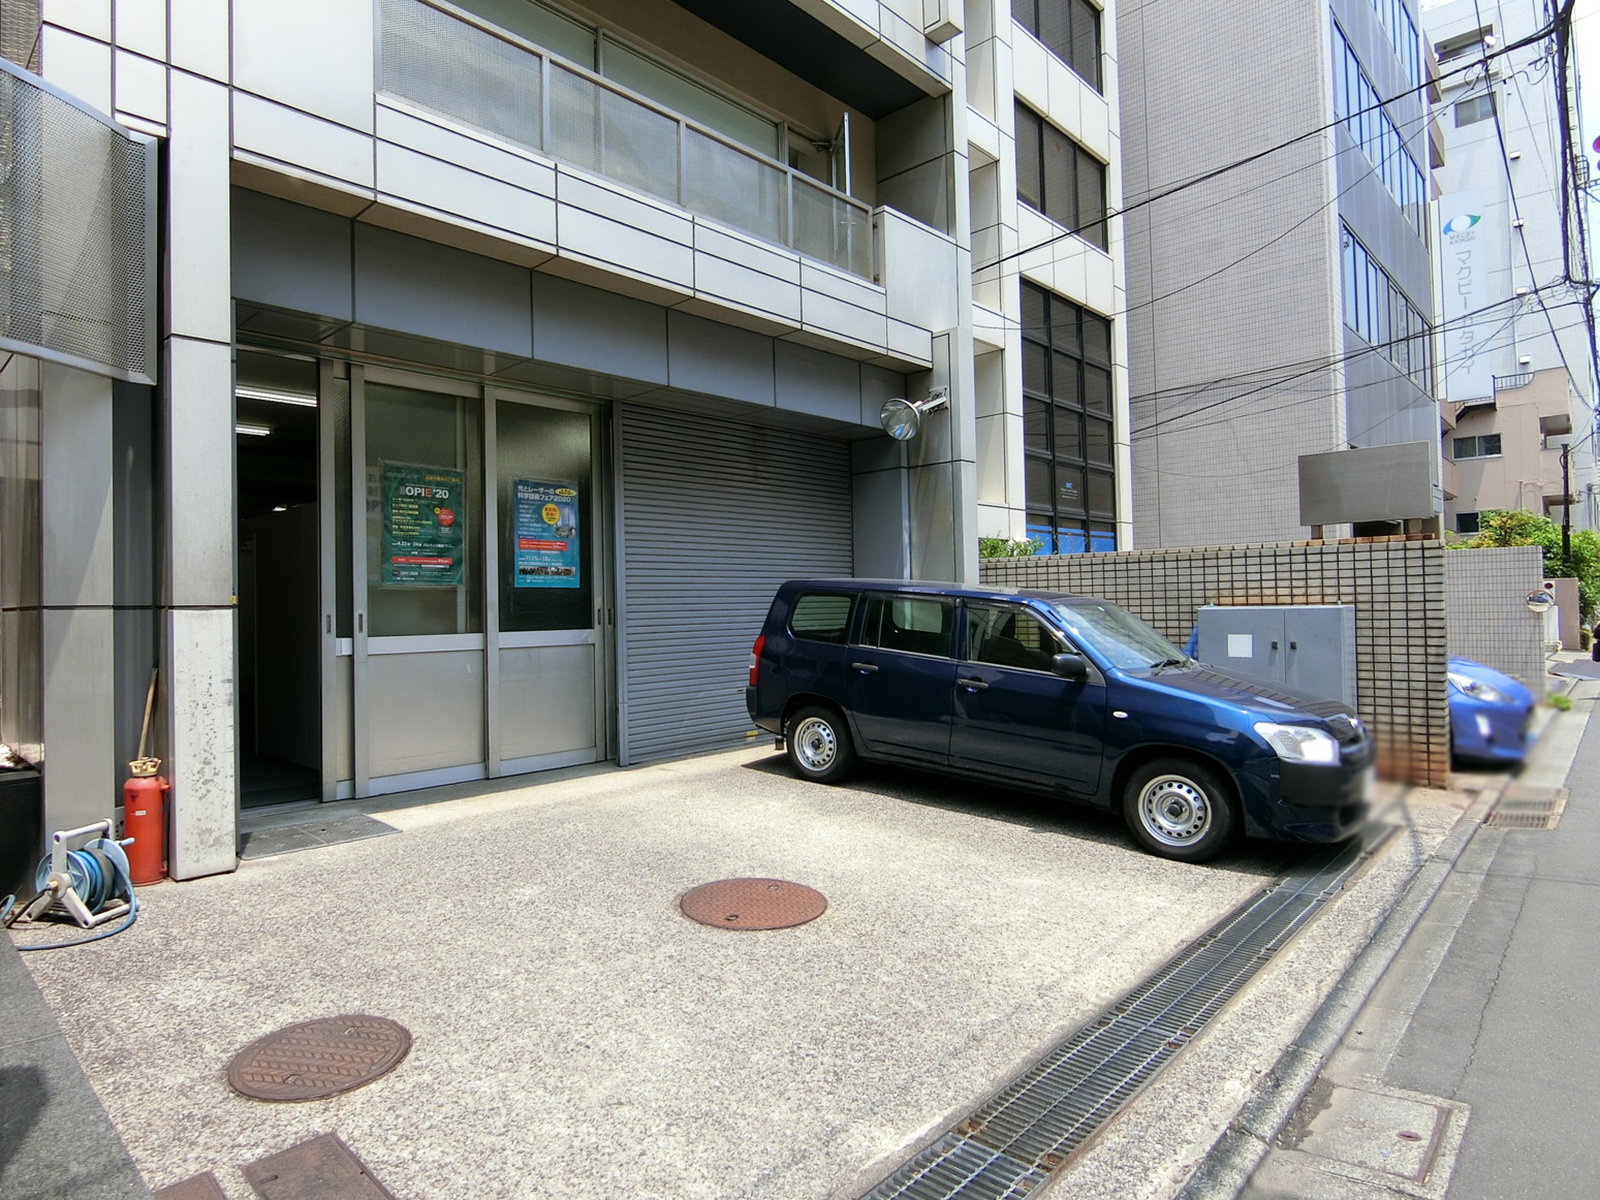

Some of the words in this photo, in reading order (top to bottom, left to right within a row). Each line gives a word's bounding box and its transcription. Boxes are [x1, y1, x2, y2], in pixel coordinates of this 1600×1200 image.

[405, 486, 432, 498] OPIE
[517, 485, 555, 495] 光とレーザーの
